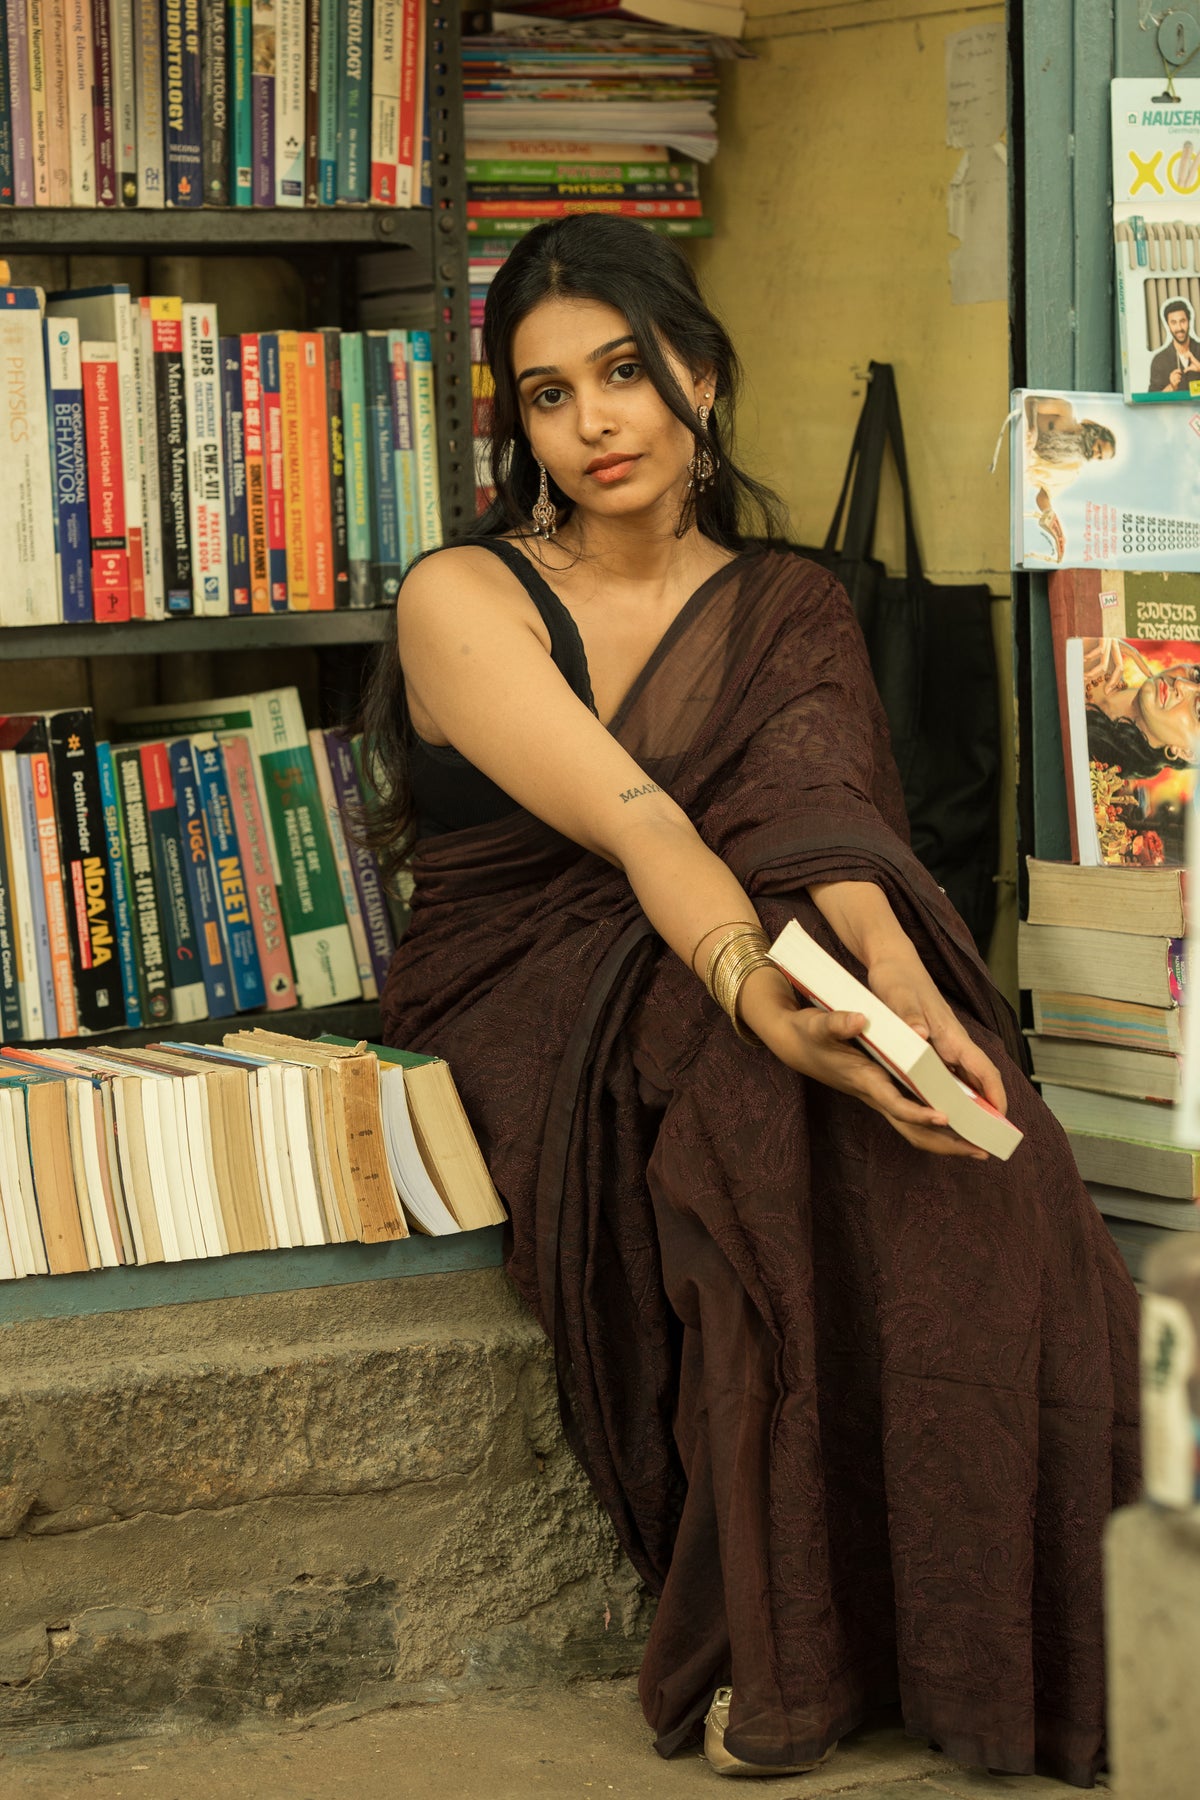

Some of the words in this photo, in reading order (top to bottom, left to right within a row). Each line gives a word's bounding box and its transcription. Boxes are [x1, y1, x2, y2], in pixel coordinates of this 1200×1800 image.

[32, 28, 44, 93] Neuroanatomy
[54, 20, 65, 68] Practical
[76, 35, 87, 91] Education
[186, 35, 200, 55] OF
[213, 35, 226, 52] OF
[309, 25, 320, 94] Parasitology
[9, 37, 22, 110] PHYSIOLOGY
[214, 57, 227, 130] HISTOLOGY
[292, 53, 302, 112] DATABASE
[55, 69, 67, 130] Physiology
[102, 76, 111, 133] HISTOLOGY
[36, 110, 46, 142] Inderbir
[36, 143, 46, 167] Singh
[557, 164, 622, 180] PHYSICS
[557, 182, 625, 195] PHYSICS
[60, 347, 71, 381] Pearson
[200, 339, 215, 377] IBPS
[5, 356, 29, 445] PHYSICS
[94, 363, 110, 402] Rapid
[166, 362, 183, 445] Marketing
[244, 379, 260, 402] SEM
[284, 361, 298, 415] DISCRETE
[419, 376, 432, 417] B.Ed.
[204, 382, 217, 439] PRELIMINARY
[351, 402, 364, 439] BASIC
[54, 402, 77, 505] BEHAVIOR
[71, 402, 87, 505] ORGANIZATIONAL
[97, 405, 114, 488] Instructional
[229, 411, 243, 461] Business
[378, 429, 393, 484] Machines
[203, 444, 221, 501] CWE-VII
[232, 462, 246, 498] Ethics
[287, 418, 304, 504] MATHEMATICAL
[353, 442, 367, 526] MATHEMATICS
[422, 423, 436, 498] SEMESTER
[169, 446, 189, 550] Management
[249, 464, 264, 506] SUNSTAR
[100, 490, 116, 534] Design
[196, 505, 209, 537] WORK
[252, 508, 265, 536] EXAM
[198, 541, 211, 573] BOOK
[209, 512, 222, 565] PRACTICE
[253, 537, 267, 581] SCANNER
[290, 508, 305, 583] STRUCTURES
[176, 554, 191, 581] 12e
[315, 541, 327, 596] PEARSON
[266, 697, 288, 746] GRE
[121, 760, 142, 803] SUNSTAR
[37, 815, 57, 838] 19
[71, 770, 92, 855] Pathfinder
[104, 804, 122, 859] SBI-PO
[126, 802, 148, 846] SUCCESS
[282, 808, 304, 858] PRACTICE
[296, 806, 310, 834] BOOK
[46, 838, 60, 875] YEARS
[131, 845, 151, 875] GUIDE
[186, 819, 206, 863] UGC
[301, 835, 314, 851] OF
[113, 861, 125, 900] Previous
[166, 837, 185, 895] COMPUTER
[291, 860, 315, 915] PROBLEMS
[82, 856, 114, 968] NDA/NA
[217, 857, 251, 925] NEET
[356, 868, 392, 957] CHEMISTRY
[2, 929, 12, 949] and
[117, 901, 130, 930] Years'
[174, 896, 191, 940] SCIENCE
[3, 949, 15, 990] Circuits
[119, 930, 132, 963] Papers
